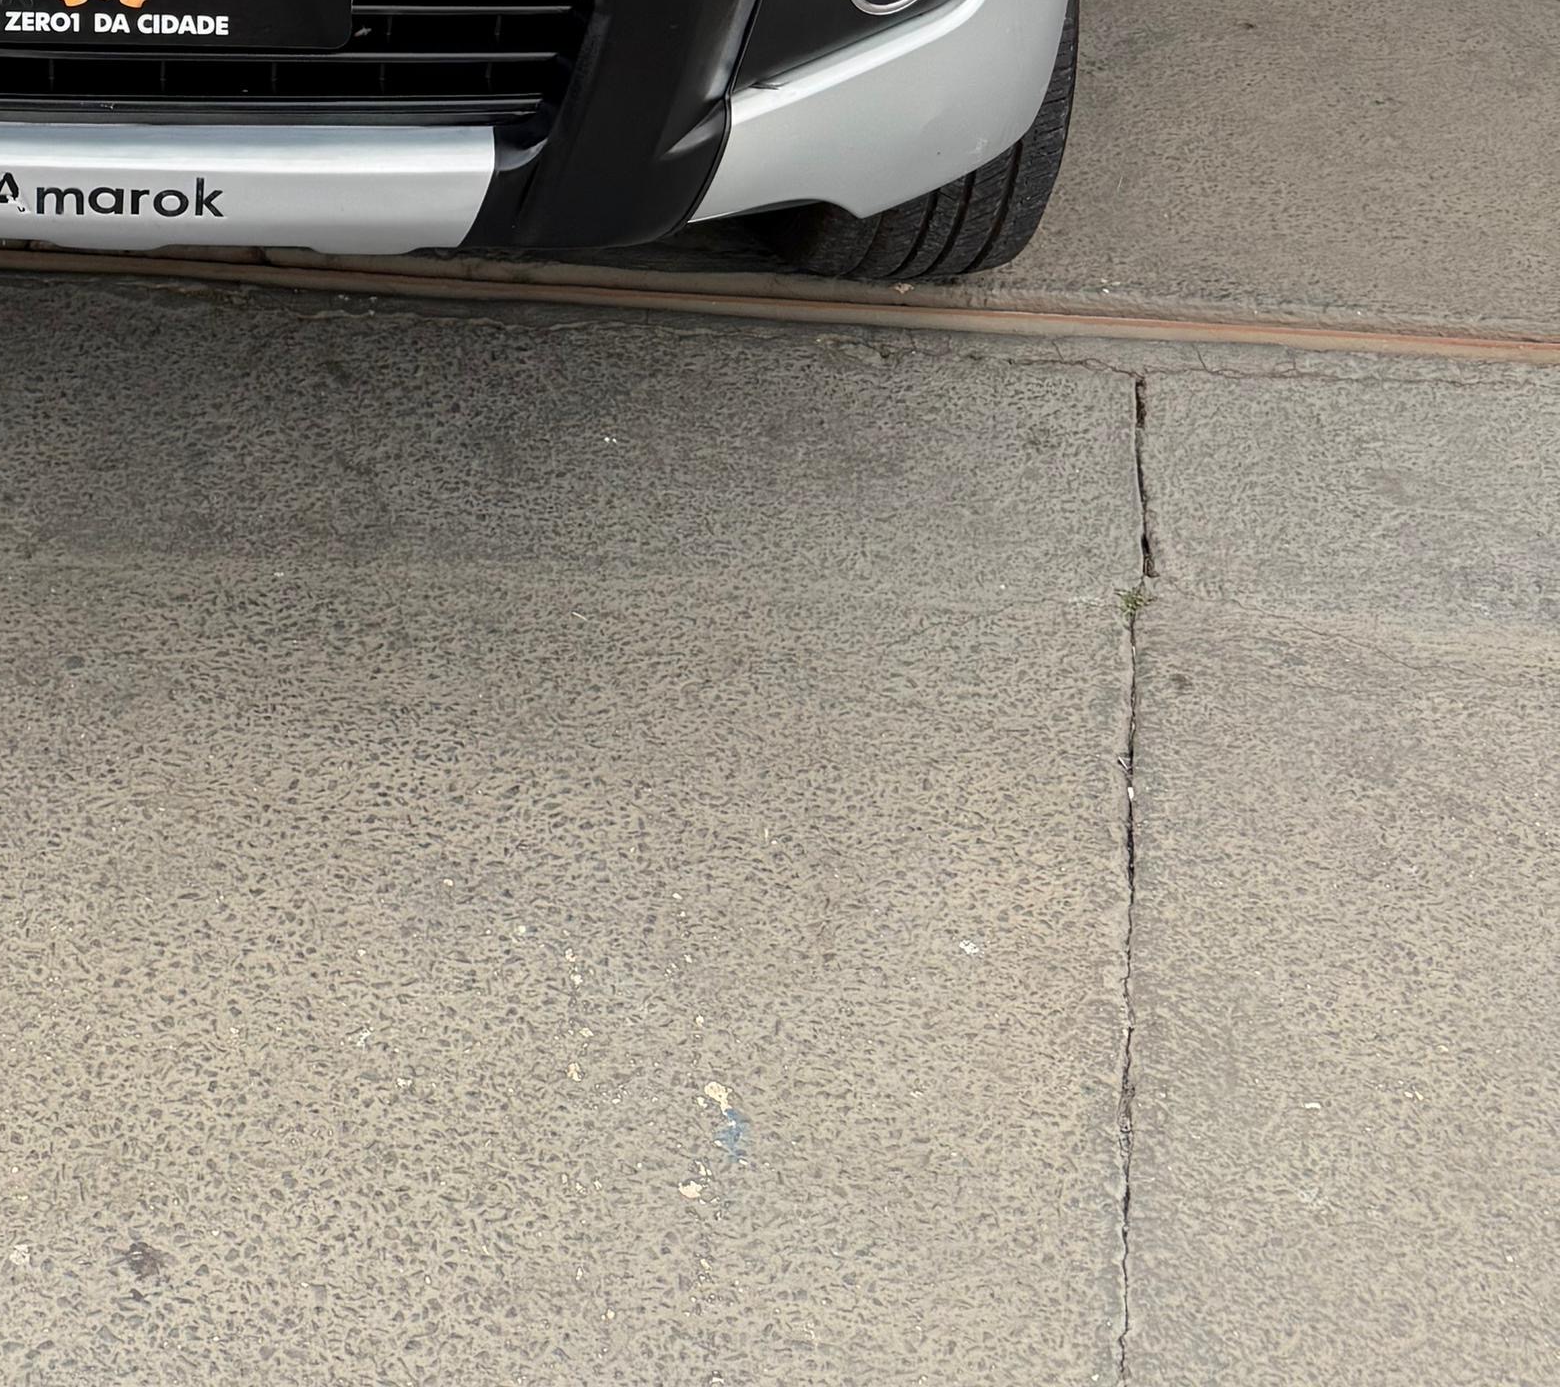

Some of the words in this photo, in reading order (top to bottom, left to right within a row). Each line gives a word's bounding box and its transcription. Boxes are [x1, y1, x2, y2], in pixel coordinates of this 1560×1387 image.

[4, 10, 81, 33] ZERO1
[93, 12, 131, 34] DA
[136, 14, 230, 36] CIDADE
